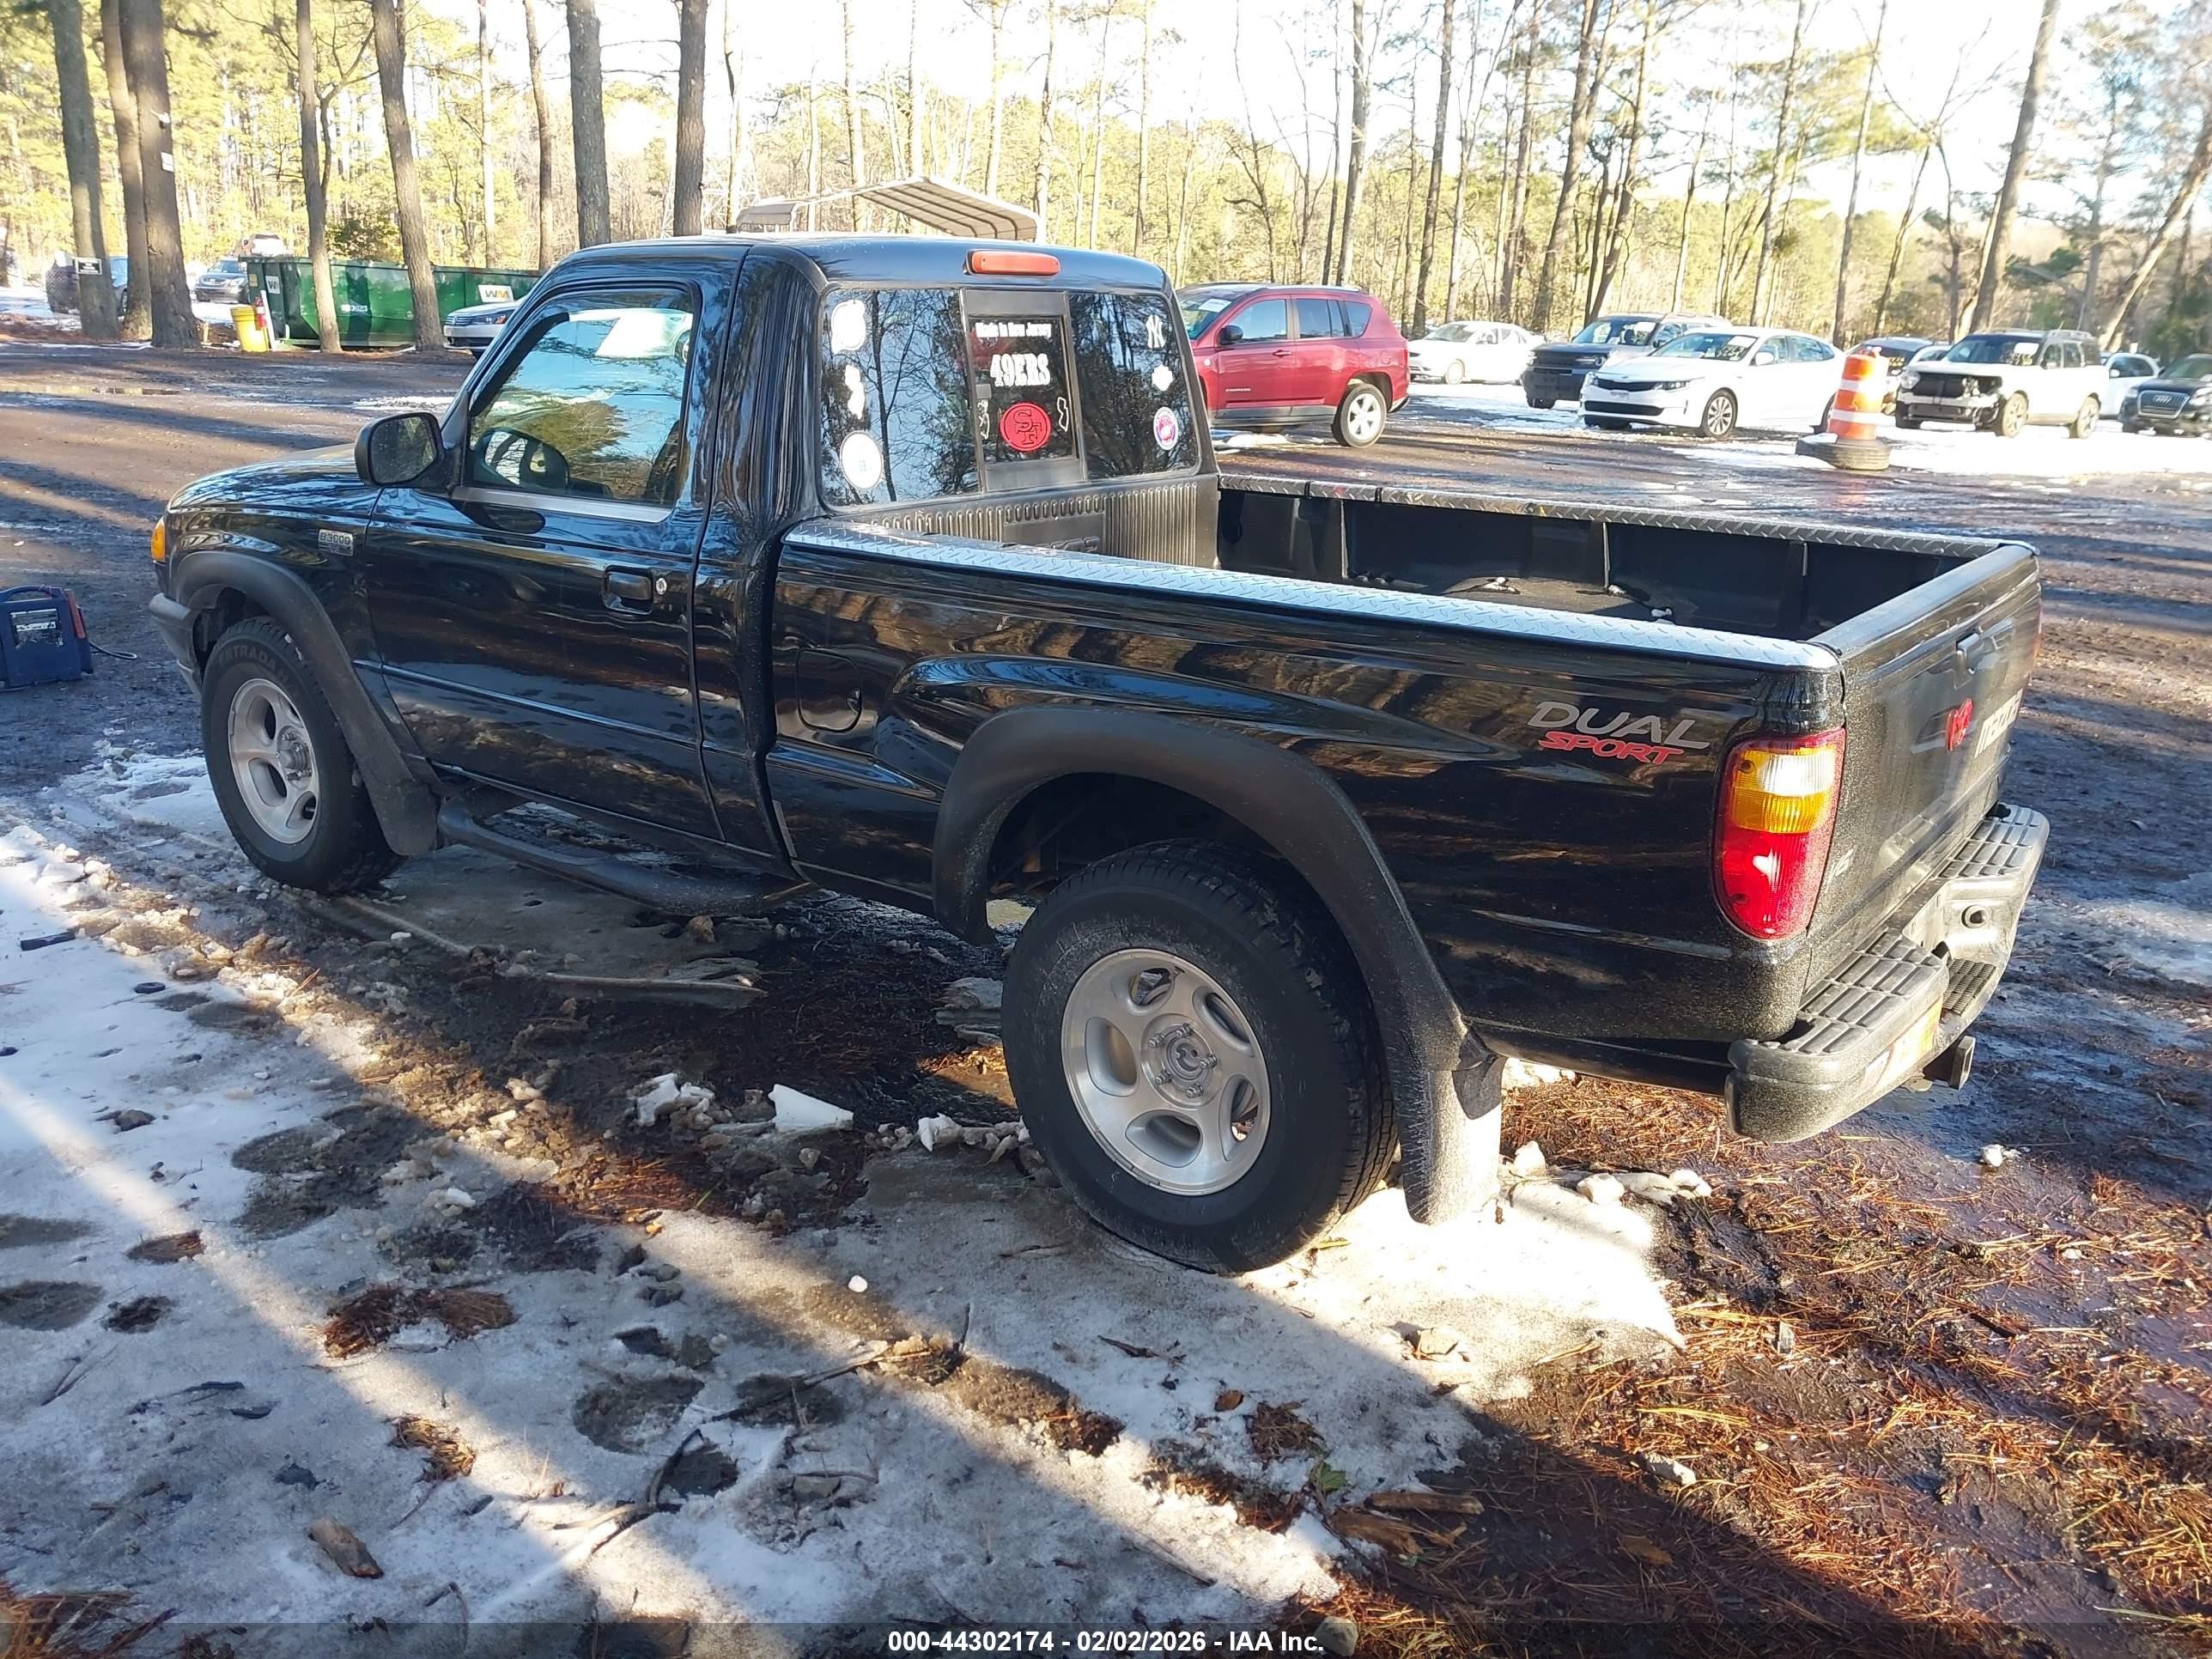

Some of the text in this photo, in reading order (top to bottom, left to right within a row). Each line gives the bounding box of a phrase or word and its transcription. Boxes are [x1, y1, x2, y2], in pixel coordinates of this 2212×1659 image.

[484, 289, 509, 299] WM
[975, 321, 999, 338] Made
[1008, 321, 1025, 337] New
[1026, 321, 1052, 339] Jersey
[990, 353, 1051, 387] 49ERS
[319, 532, 352, 545] B3000
[1527, 700, 1711, 750] DUAL
[1538, 730, 1685, 766] SPORT
